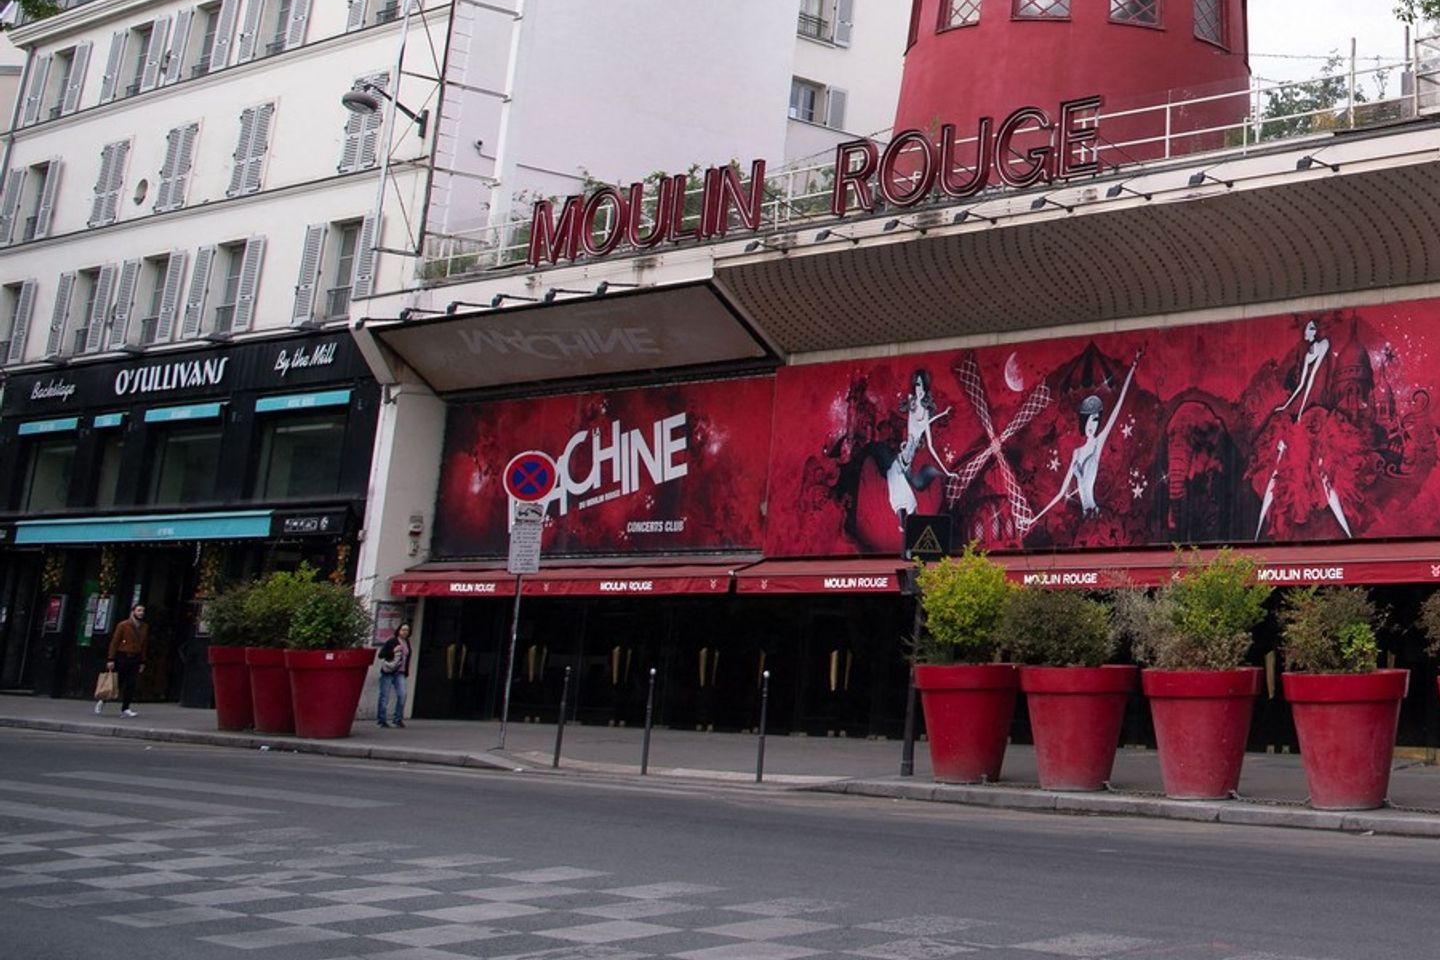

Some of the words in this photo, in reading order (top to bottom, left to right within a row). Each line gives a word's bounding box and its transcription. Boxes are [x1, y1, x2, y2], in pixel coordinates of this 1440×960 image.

[526, 158, 766, 266] MOULIN
[832, 95, 1104, 217] ROUGE
[274, 350, 290, 377] By
[309, 342, 338, 366] Mill
[115, 357, 229, 396] O'SULLIVANS
[30, 378, 77, 402] Backstage
[1063, 573, 1098, 584] ROUGE
[1258, 569, 1301, 580] MOULIN
[1304, 567, 1344, 579] ROUGE
[450, 583, 475, 593] MOULIN
[475, 583, 496, 592] ROUGE
[600, 581, 627, 591] MOULIN
[628, 581, 653, 590] ROUGE
[824, 578, 856, 588] MOULIN
[857, 578, 888, 588] ROUGE
